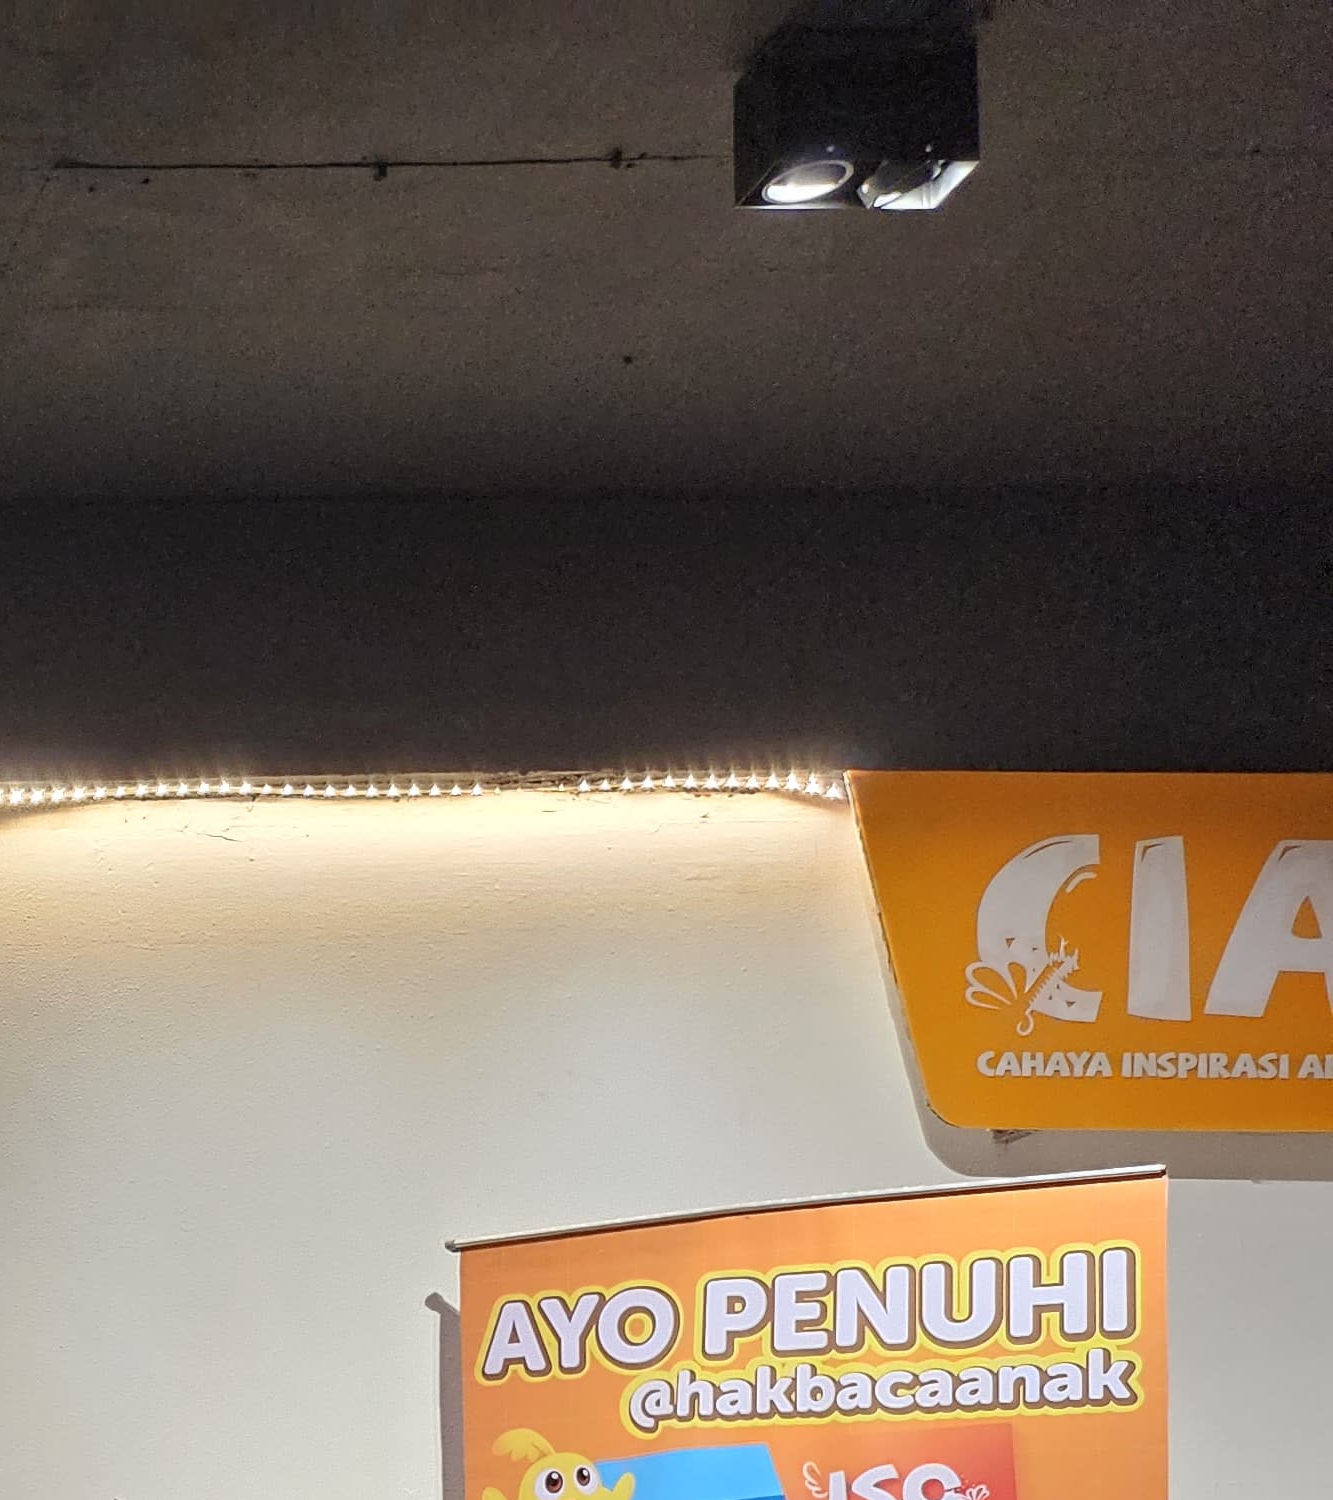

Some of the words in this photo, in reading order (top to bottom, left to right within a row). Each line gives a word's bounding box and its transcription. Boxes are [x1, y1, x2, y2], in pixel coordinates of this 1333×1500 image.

[976, 833, 1333, 1023] CIA
[977, 1050, 1112, 1077] CAHAYA
[1122, 1052, 1289, 1079] INSPIRASI
[1297, 1055, 1333, 1078] A
[480, 1288, 679, 1380] AYO
[701, 1247, 1139, 1359] PENUHI
[629, 1348, 1138, 1432] @hakbacaanak
